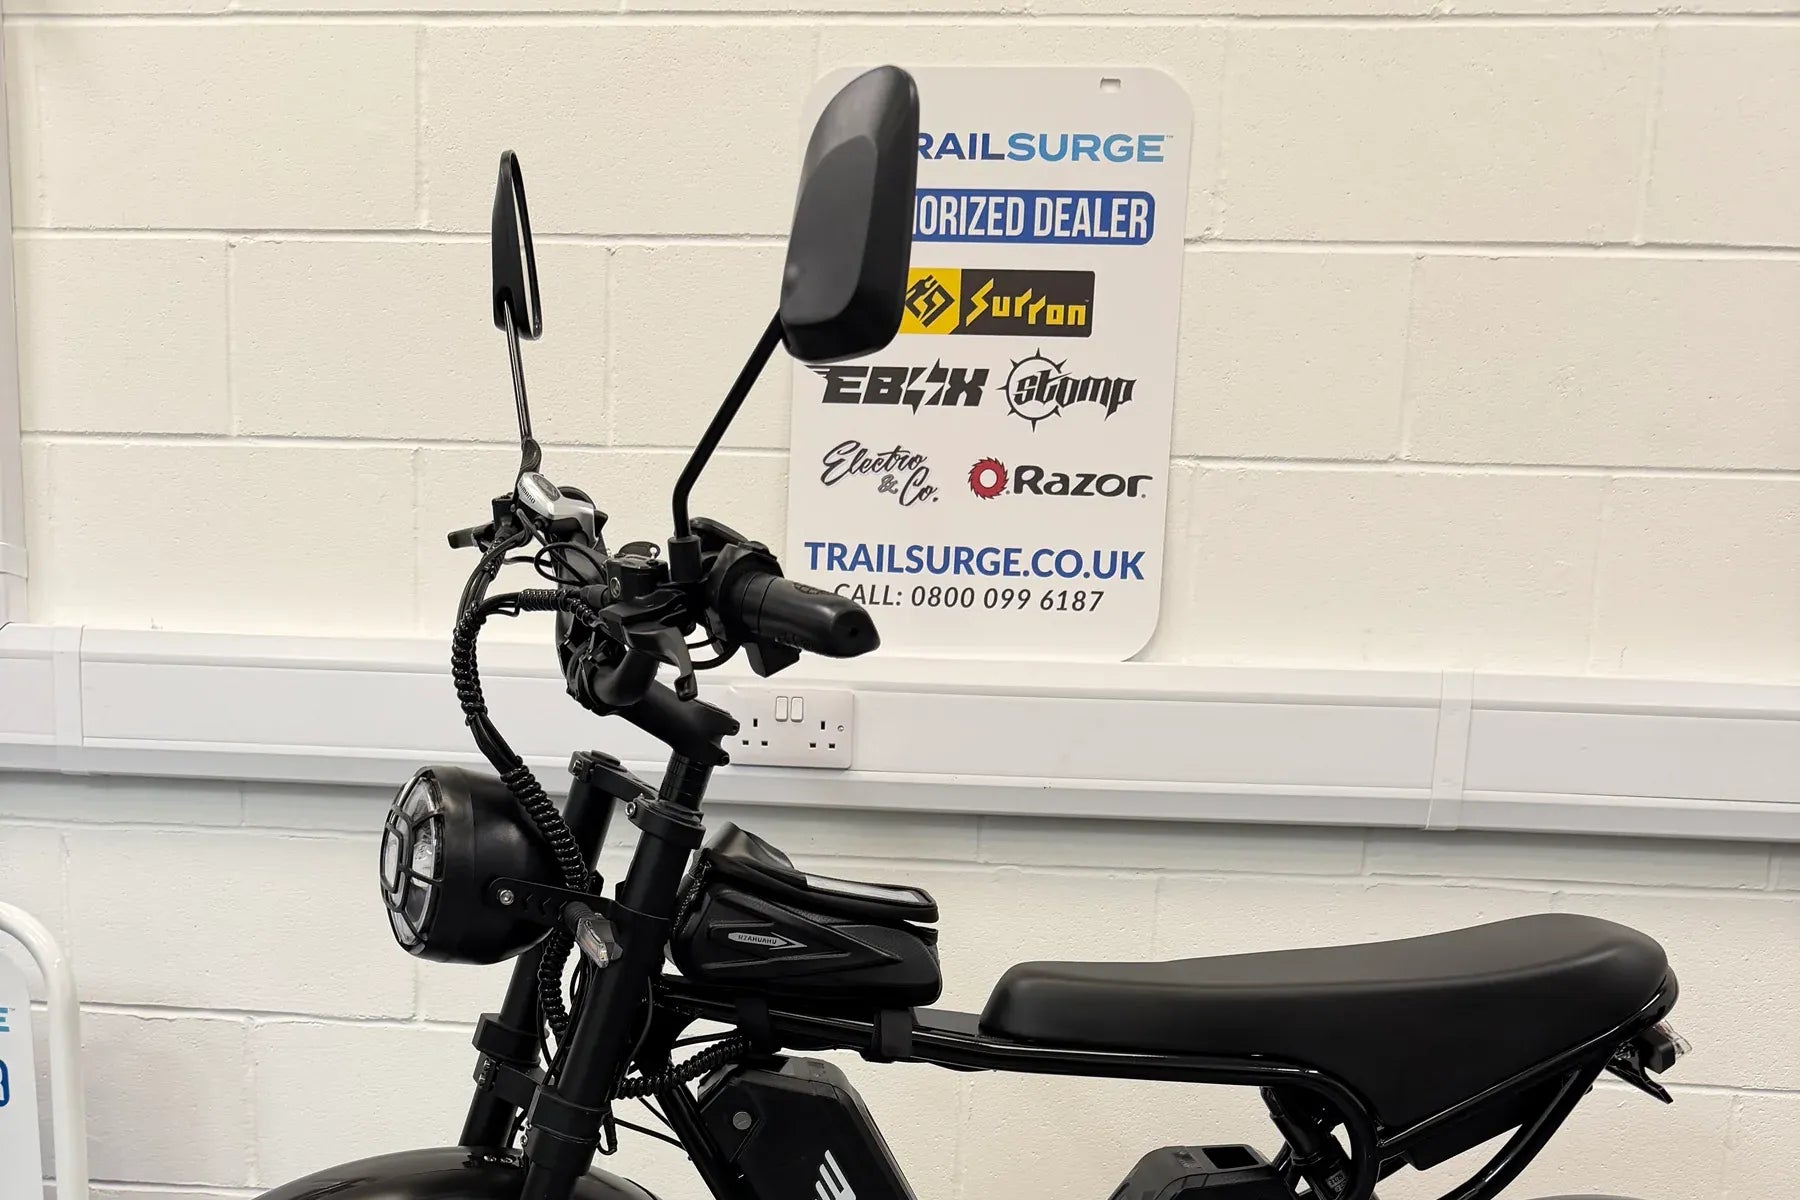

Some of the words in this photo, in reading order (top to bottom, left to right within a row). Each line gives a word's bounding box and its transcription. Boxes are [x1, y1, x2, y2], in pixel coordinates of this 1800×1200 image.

[917, 132, 1165, 163] RAILSURGE
[912, 195, 1025, 238] ORIZED
[1034, 196, 1149, 239] DEALER
[966, 278, 1087, 327] Surron
[820, 439, 928, 486] Electro
[878, 474, 898, 495] &
[899, 467, 939, 507] Co.
[804, 541, 1146, 580] TRAILSURGE.CO.UK
[833, 582, 903, 607] CALL:
[911, 584, 975, 609] 0800
[983, 586, 1032, 611] 099
[1039, 588, 1105, 613] 6187
